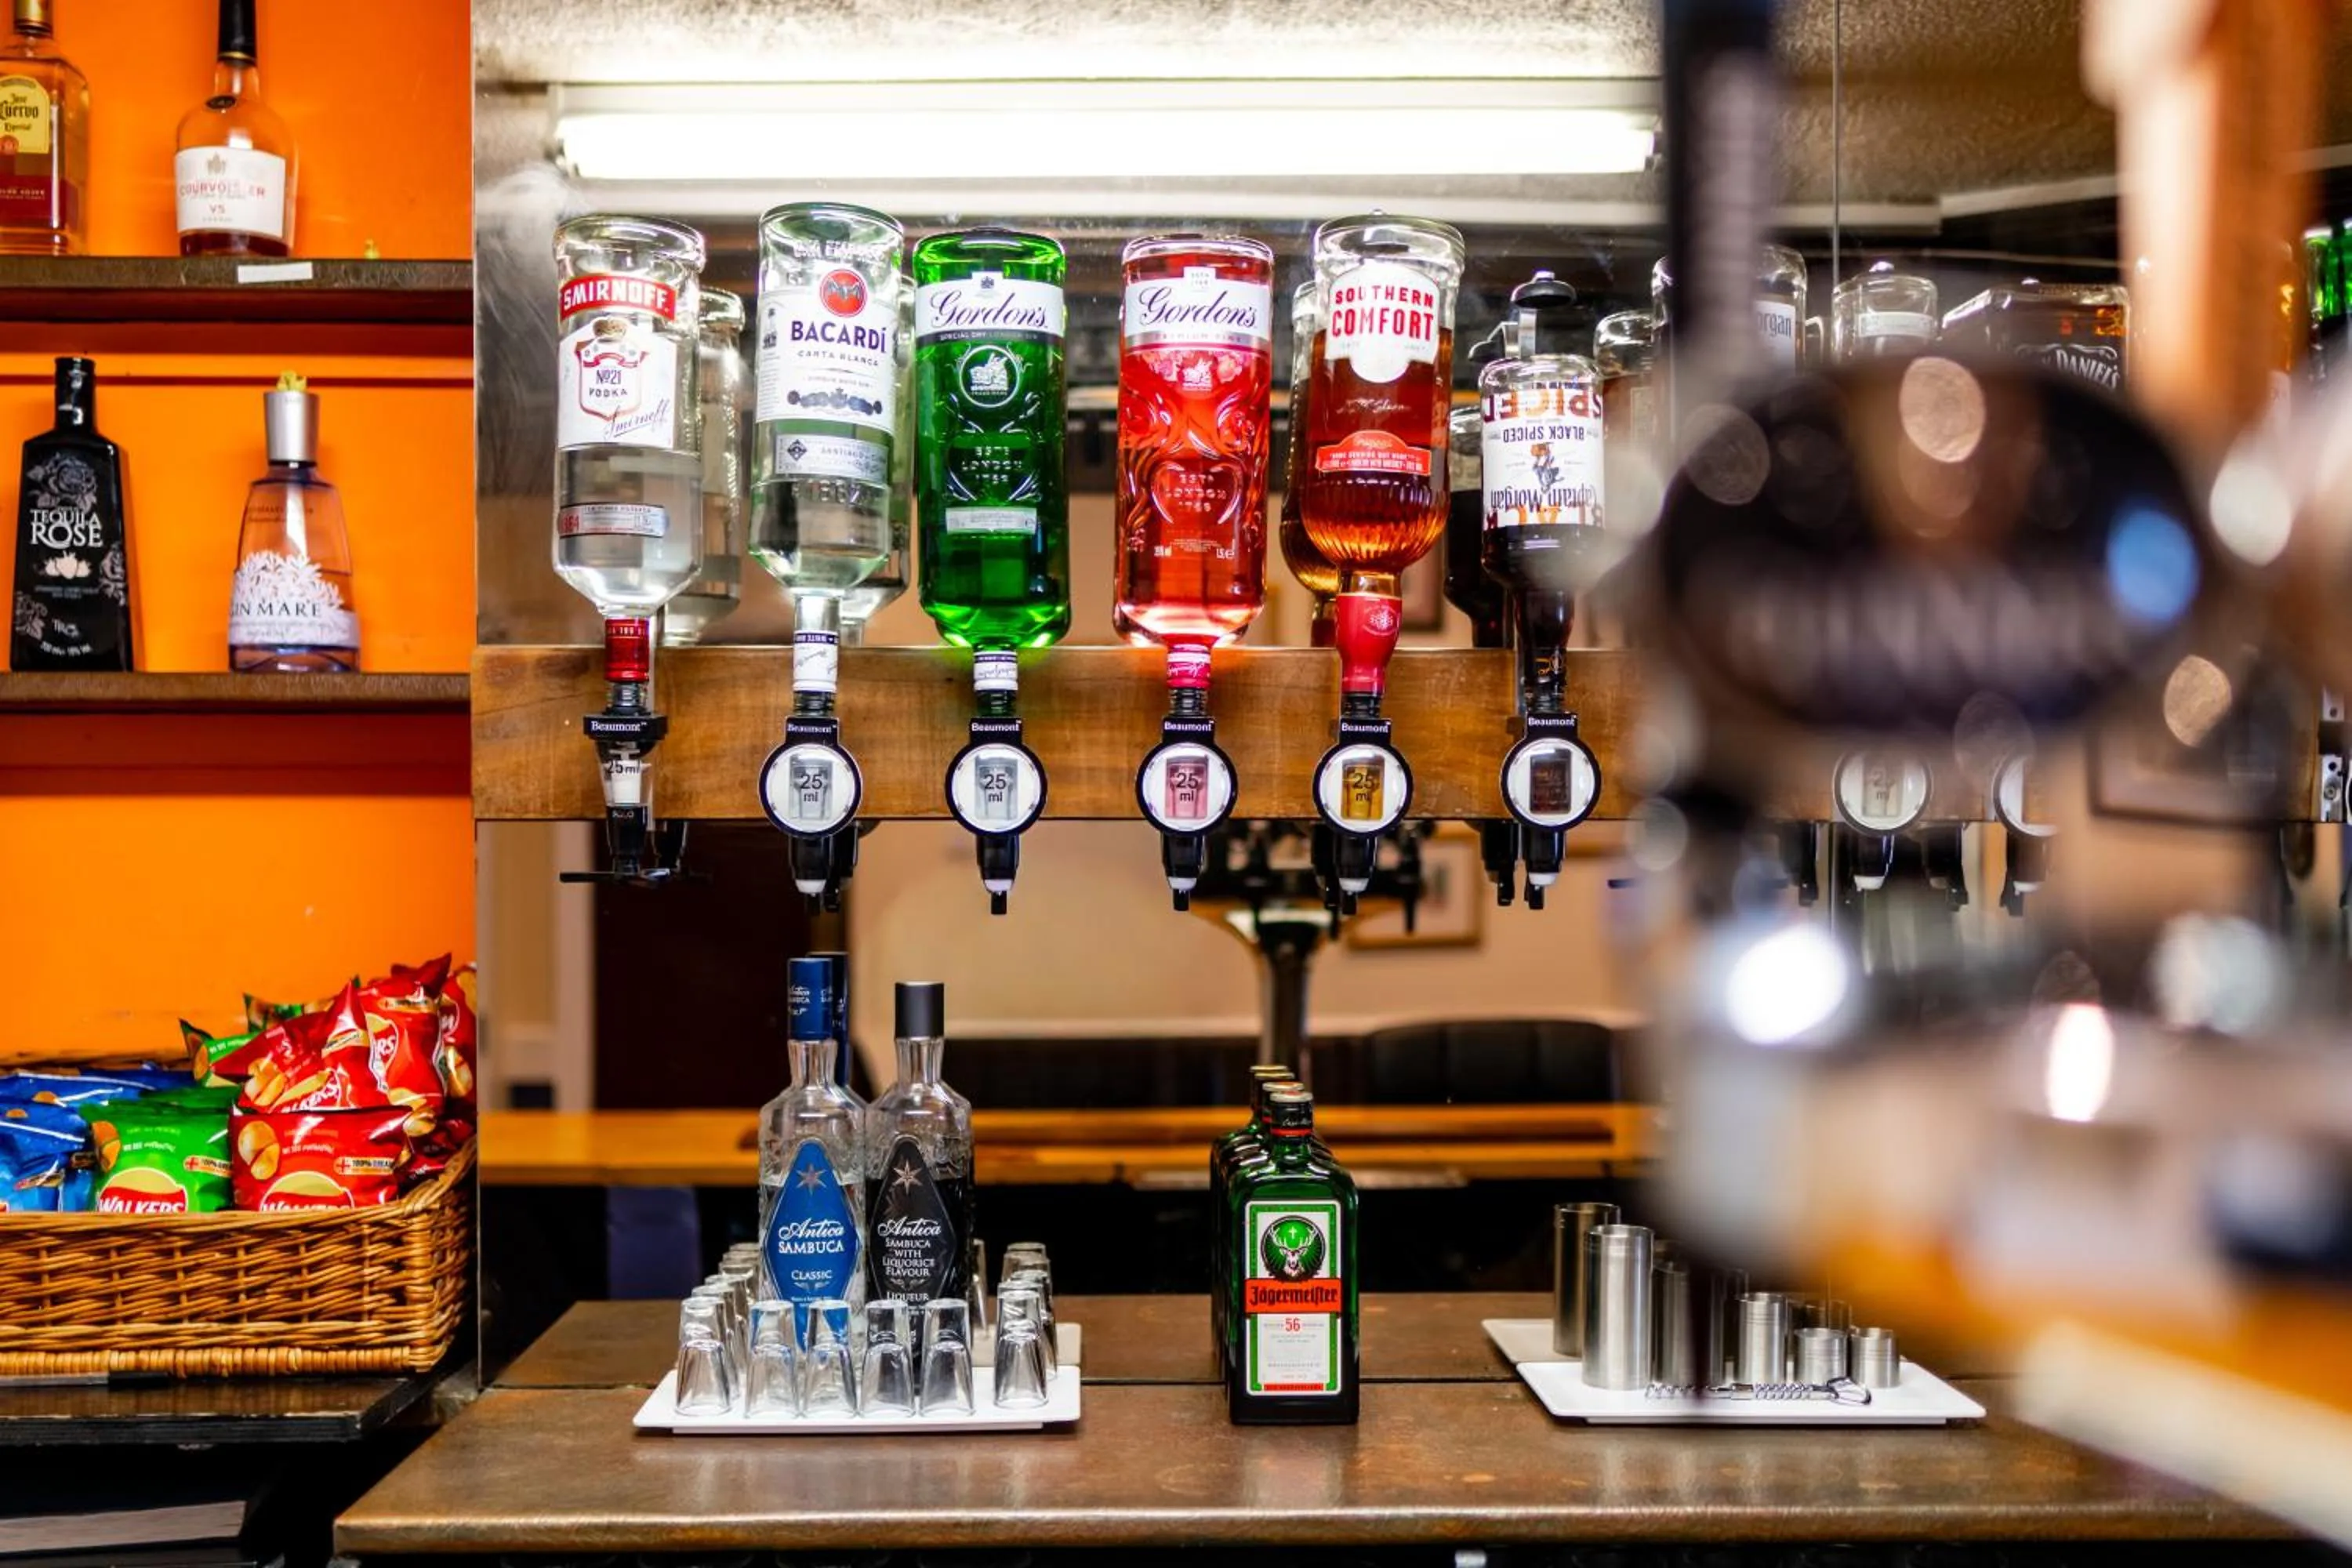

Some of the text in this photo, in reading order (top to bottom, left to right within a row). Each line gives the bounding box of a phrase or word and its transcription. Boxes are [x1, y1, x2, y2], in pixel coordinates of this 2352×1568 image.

[209, 204, 226, 214] VS
[563, 278, 667, 311] SMIRNOFF
[1335, 285, 1434, 309] SOUTHERN
[930, 289, 1047, 329] Gordon's
[1138, 286, 1258, 328] Gordon's
[1331, 307, 1435, 342] COMFORT
[1755, 312, 1791, 339] organ
[589, 387, 629, 397] VODKA
[1502, 425, 1585, 443] BLACK SPICED
[1490, 483, 1597, 513] Captain Morgan
[30, 508, 102, 530] TEQUILA
[30, 521, 103, 549] ROSE
[256, 601, 322, 617] MARE
[608, 761, 623, 774] 25
[800, 773, 822, 789] 25
[984, 773, 1007, 789] 25
[1176, 772, 1199, 789] 25
[1352, 772, 1374, 789] 25
[803, 792, 818, 802] ml
[988, 791, 1003, 802] ml
[1179, 789, 1194, 801] ml
[779, 1217, 845, 1241] Antica
[877, 1216, 942, 1236] Antica
[778, 1240, 845, 1254] SAMBUCA
[885, 1237, 931, 1249] SAMBUCA
[894, 1249, 922, 1258] WITH
[882, 1256, 935, 1268] LIQUORICE
[791, 1269, 833, 1280] CLASSIC
[885, 1266, 931, 1277] FLAVOUR
[887, 1291, 930, 1301] LIQUEUR
[1284, 1317, 1301, 1332] 56
